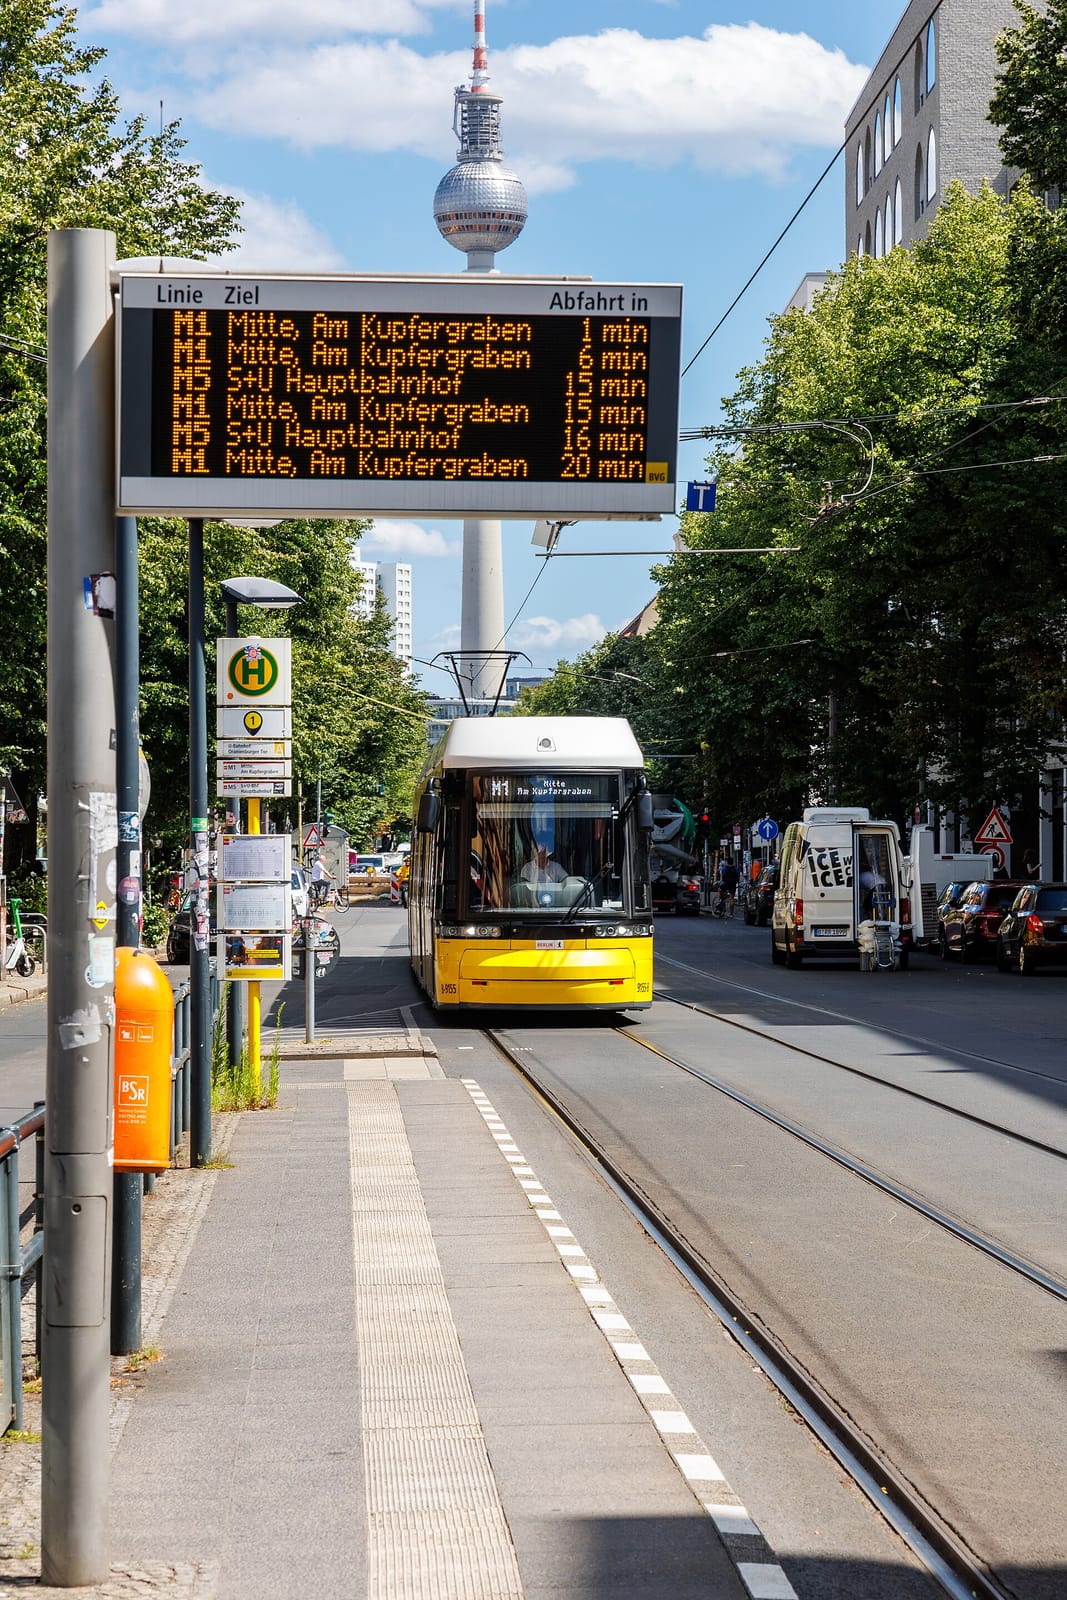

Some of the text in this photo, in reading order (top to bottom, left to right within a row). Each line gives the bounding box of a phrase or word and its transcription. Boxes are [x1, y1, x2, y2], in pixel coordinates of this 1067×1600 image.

[157, 284, 648, 311] Linie Ziel Abfahrt in
[174, 310, 648, 343] M1 Mitte, Am Kupfergraben 1 min
[173, 338, 647, 371] M1 Mitte, Am Kupfergraben 6 min
[173, 366, 646, 397] M5 S+U Hauptbahnhof 15 min
[173, 393, 645, 425] M1 Mitte, Am Kupfergraben 15 min
[172, 421, 644, 451] M5 S+U Hauptbahnhof 16 min
[172, 448, 643, 480] M1 Mitte, Am Kupfergraben 20 min
[649, 473, 665, 481] BVG
[242, 658, 265, 685] H
[250, 716, 255, 725] 1
[491, 780, 509, 796] M1
[517, 787, 592, 796] Am Kupfergraben
[808, 851, 841, 873] ICE
[811, 868, 845, 888] ICE
[122, 1081, 145, 1101] BSR
